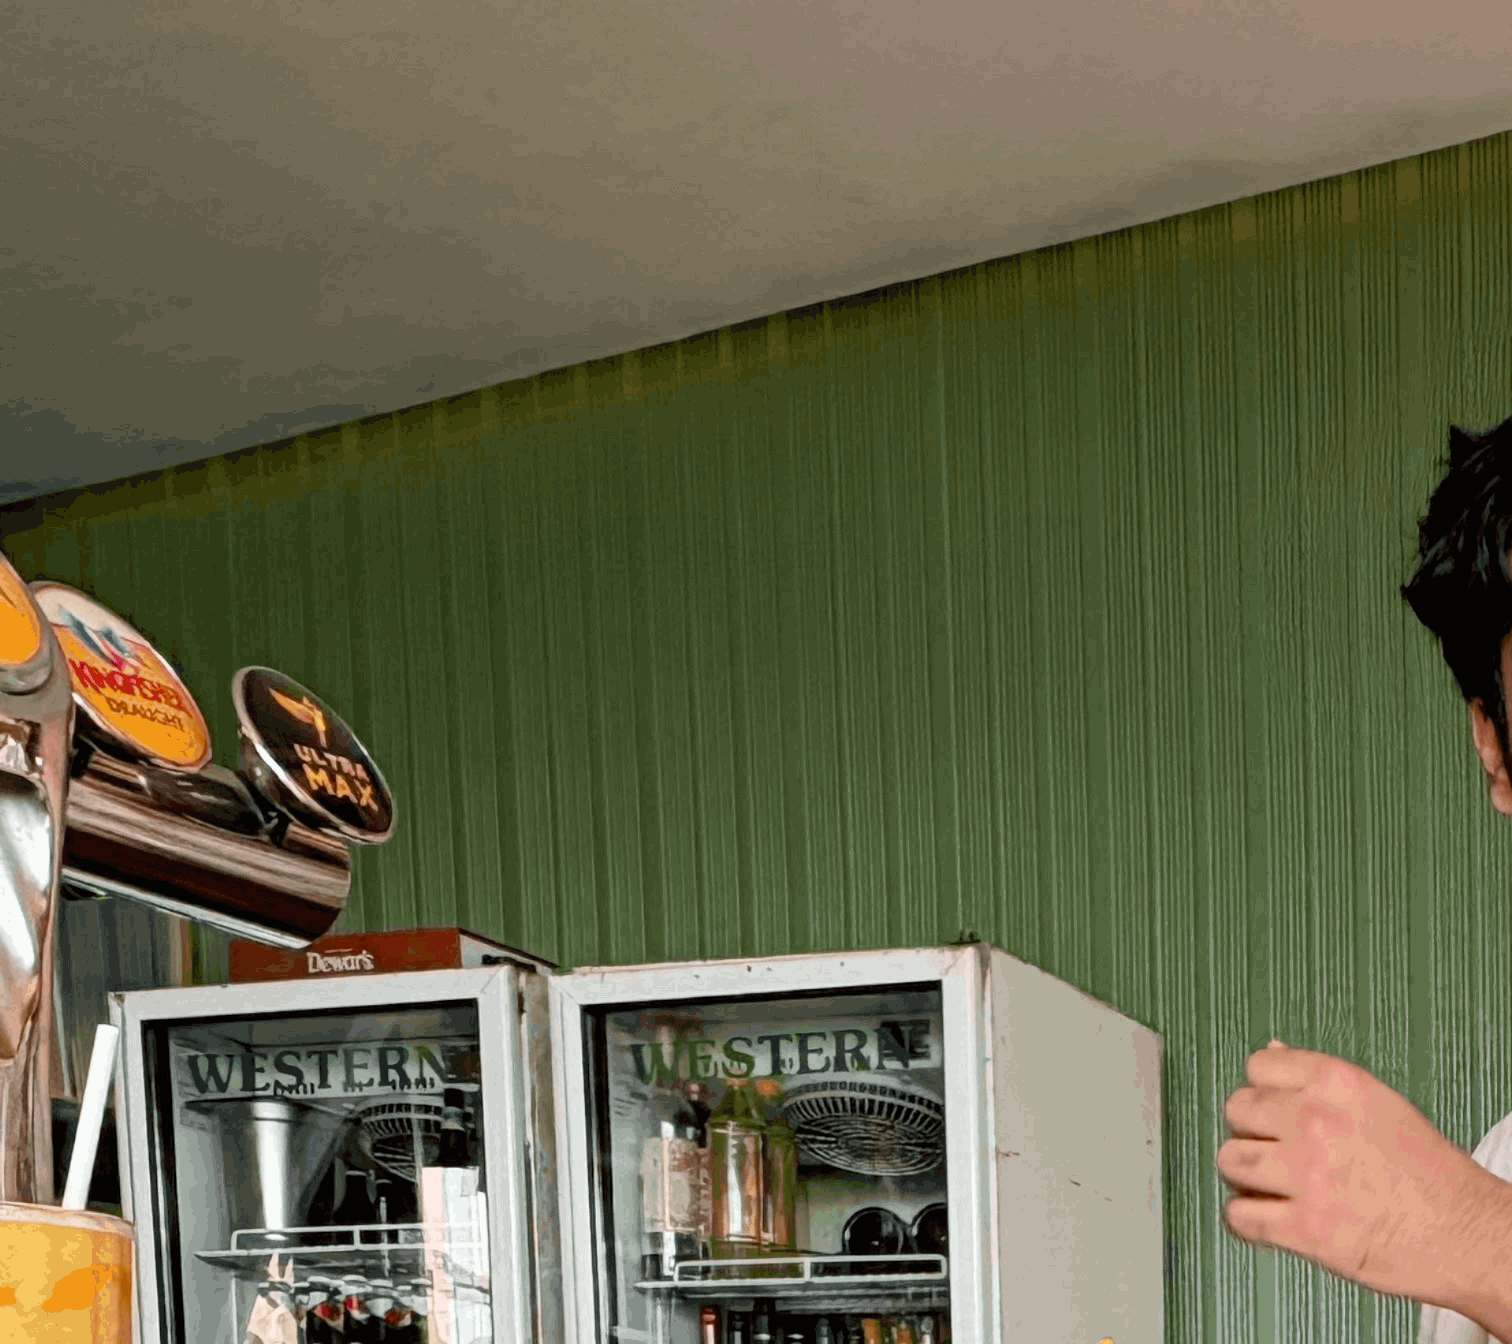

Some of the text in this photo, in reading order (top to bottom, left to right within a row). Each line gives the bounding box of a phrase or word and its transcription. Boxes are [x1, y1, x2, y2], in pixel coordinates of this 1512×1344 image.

[293, 743, 370, 782] ULTRA
[302, 763, 379, 812] MAX
[187, 1045, 448, 1094] WESTERN
[630, 1027, 912, 1086] WESTERN
